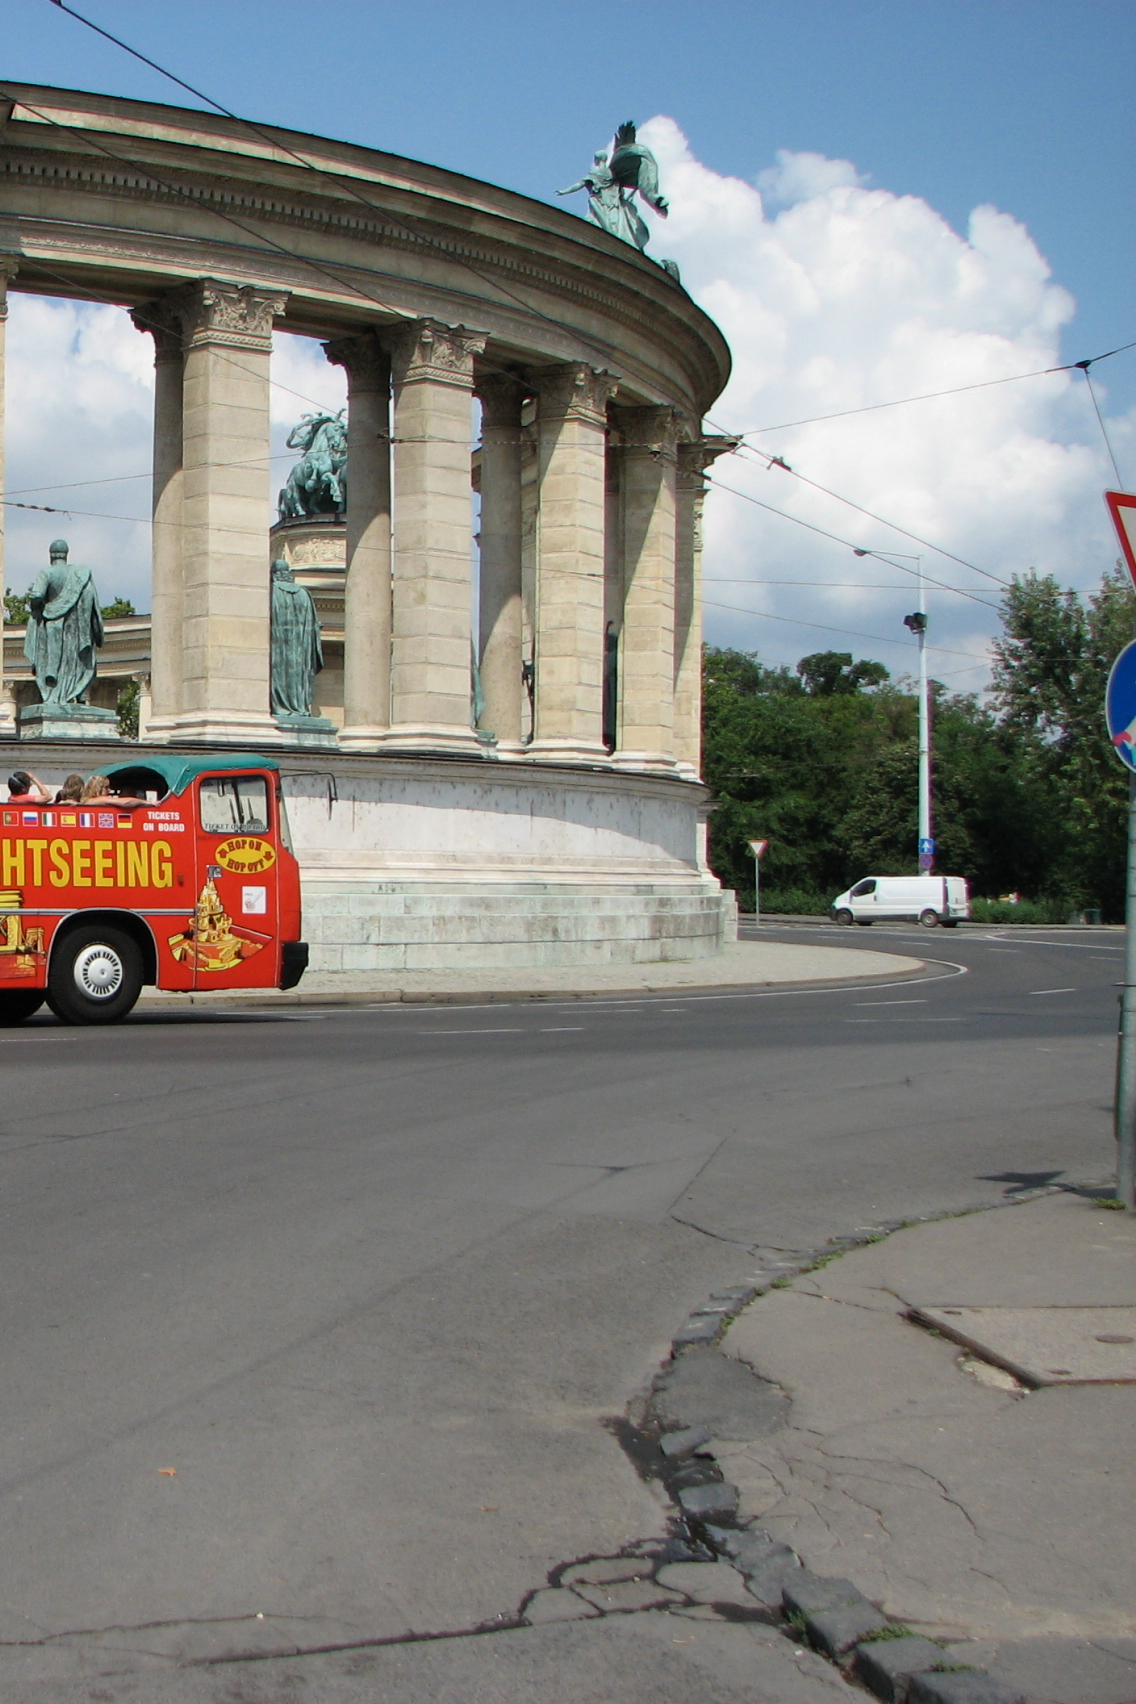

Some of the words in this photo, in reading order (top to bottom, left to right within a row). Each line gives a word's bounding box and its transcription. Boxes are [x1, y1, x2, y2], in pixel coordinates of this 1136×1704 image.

[147, 811, 180, 820] TICKETS
[143, 822, 154, 832] ON
[158, 823, 185, 832] BOARD
[226, 839, 248, 852] HOP
[248, 839, 263, 852] ON
[226, 858, 247, 873] HOP
